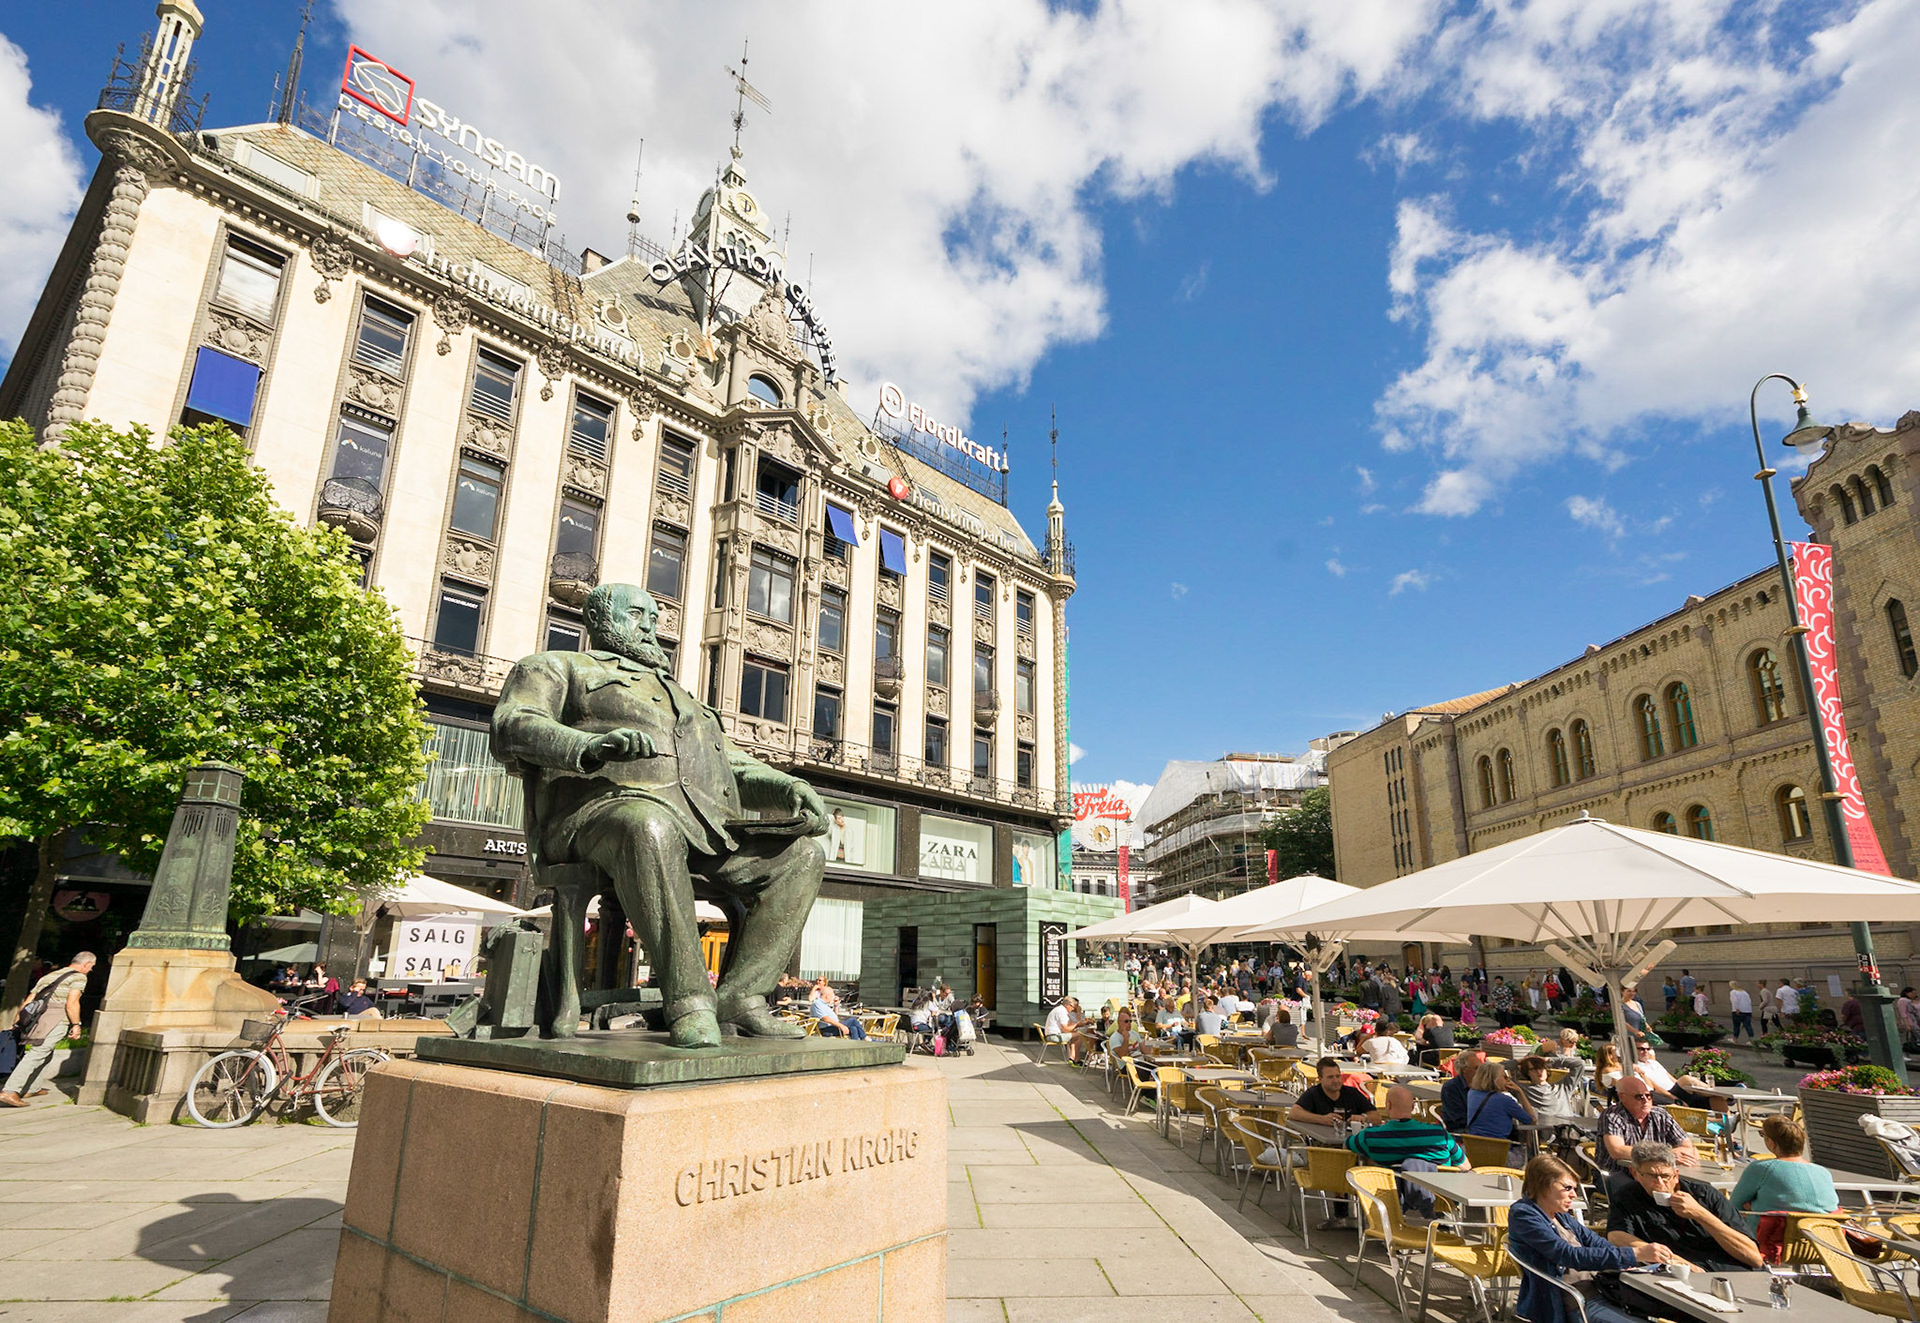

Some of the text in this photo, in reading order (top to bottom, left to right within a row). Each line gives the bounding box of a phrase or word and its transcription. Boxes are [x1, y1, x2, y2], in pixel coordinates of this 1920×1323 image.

[338, 93, 558, 228] DESIGN YOUR FACE
[649, 244, 716, 283] OLAV
[719, 244, 786, 283] THON
[359, 445, 383, 459] kaluna
[908, 400, 1002, 473] Fjordkraft
[1073, 787, 1132, 822] Freia
[483, 838, 528, 855] ARTS
[927, 841, 977, 860] ZARA
[409, 927, 465, 944] SALG
[674, 1128, 919, 1208] CHRISTIAN KROHG
